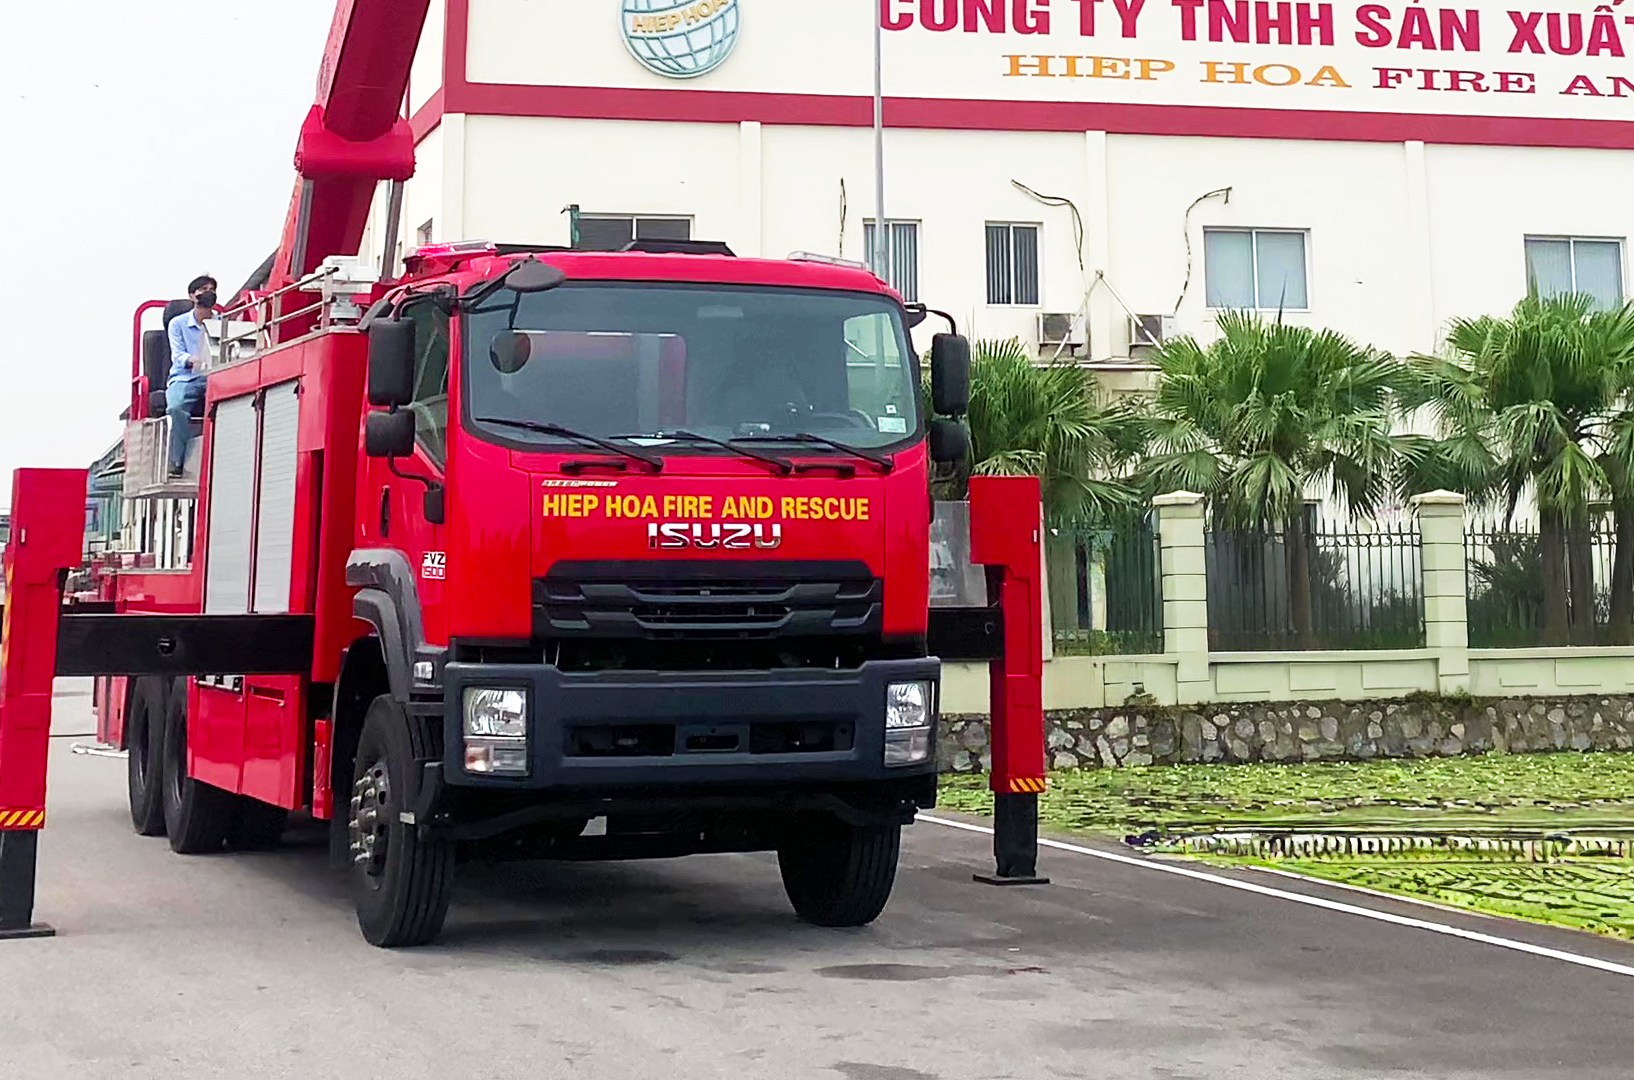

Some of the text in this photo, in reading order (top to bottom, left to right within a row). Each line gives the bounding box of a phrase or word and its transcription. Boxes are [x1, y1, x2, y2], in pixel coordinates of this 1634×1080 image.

[632, 13, 681, 33] HIEP
[1002, 55, 1175, 80] HIEP
[1199, 61, 1351, 88] HOA
[1372, 68, 1535, 93] FIRE
[544, 495, 868, 520] HIEP HOA FIRE AND RESCUE
[648, 522, 781, 550] ISUZU
[422, 552, 445, 565] FVZ
